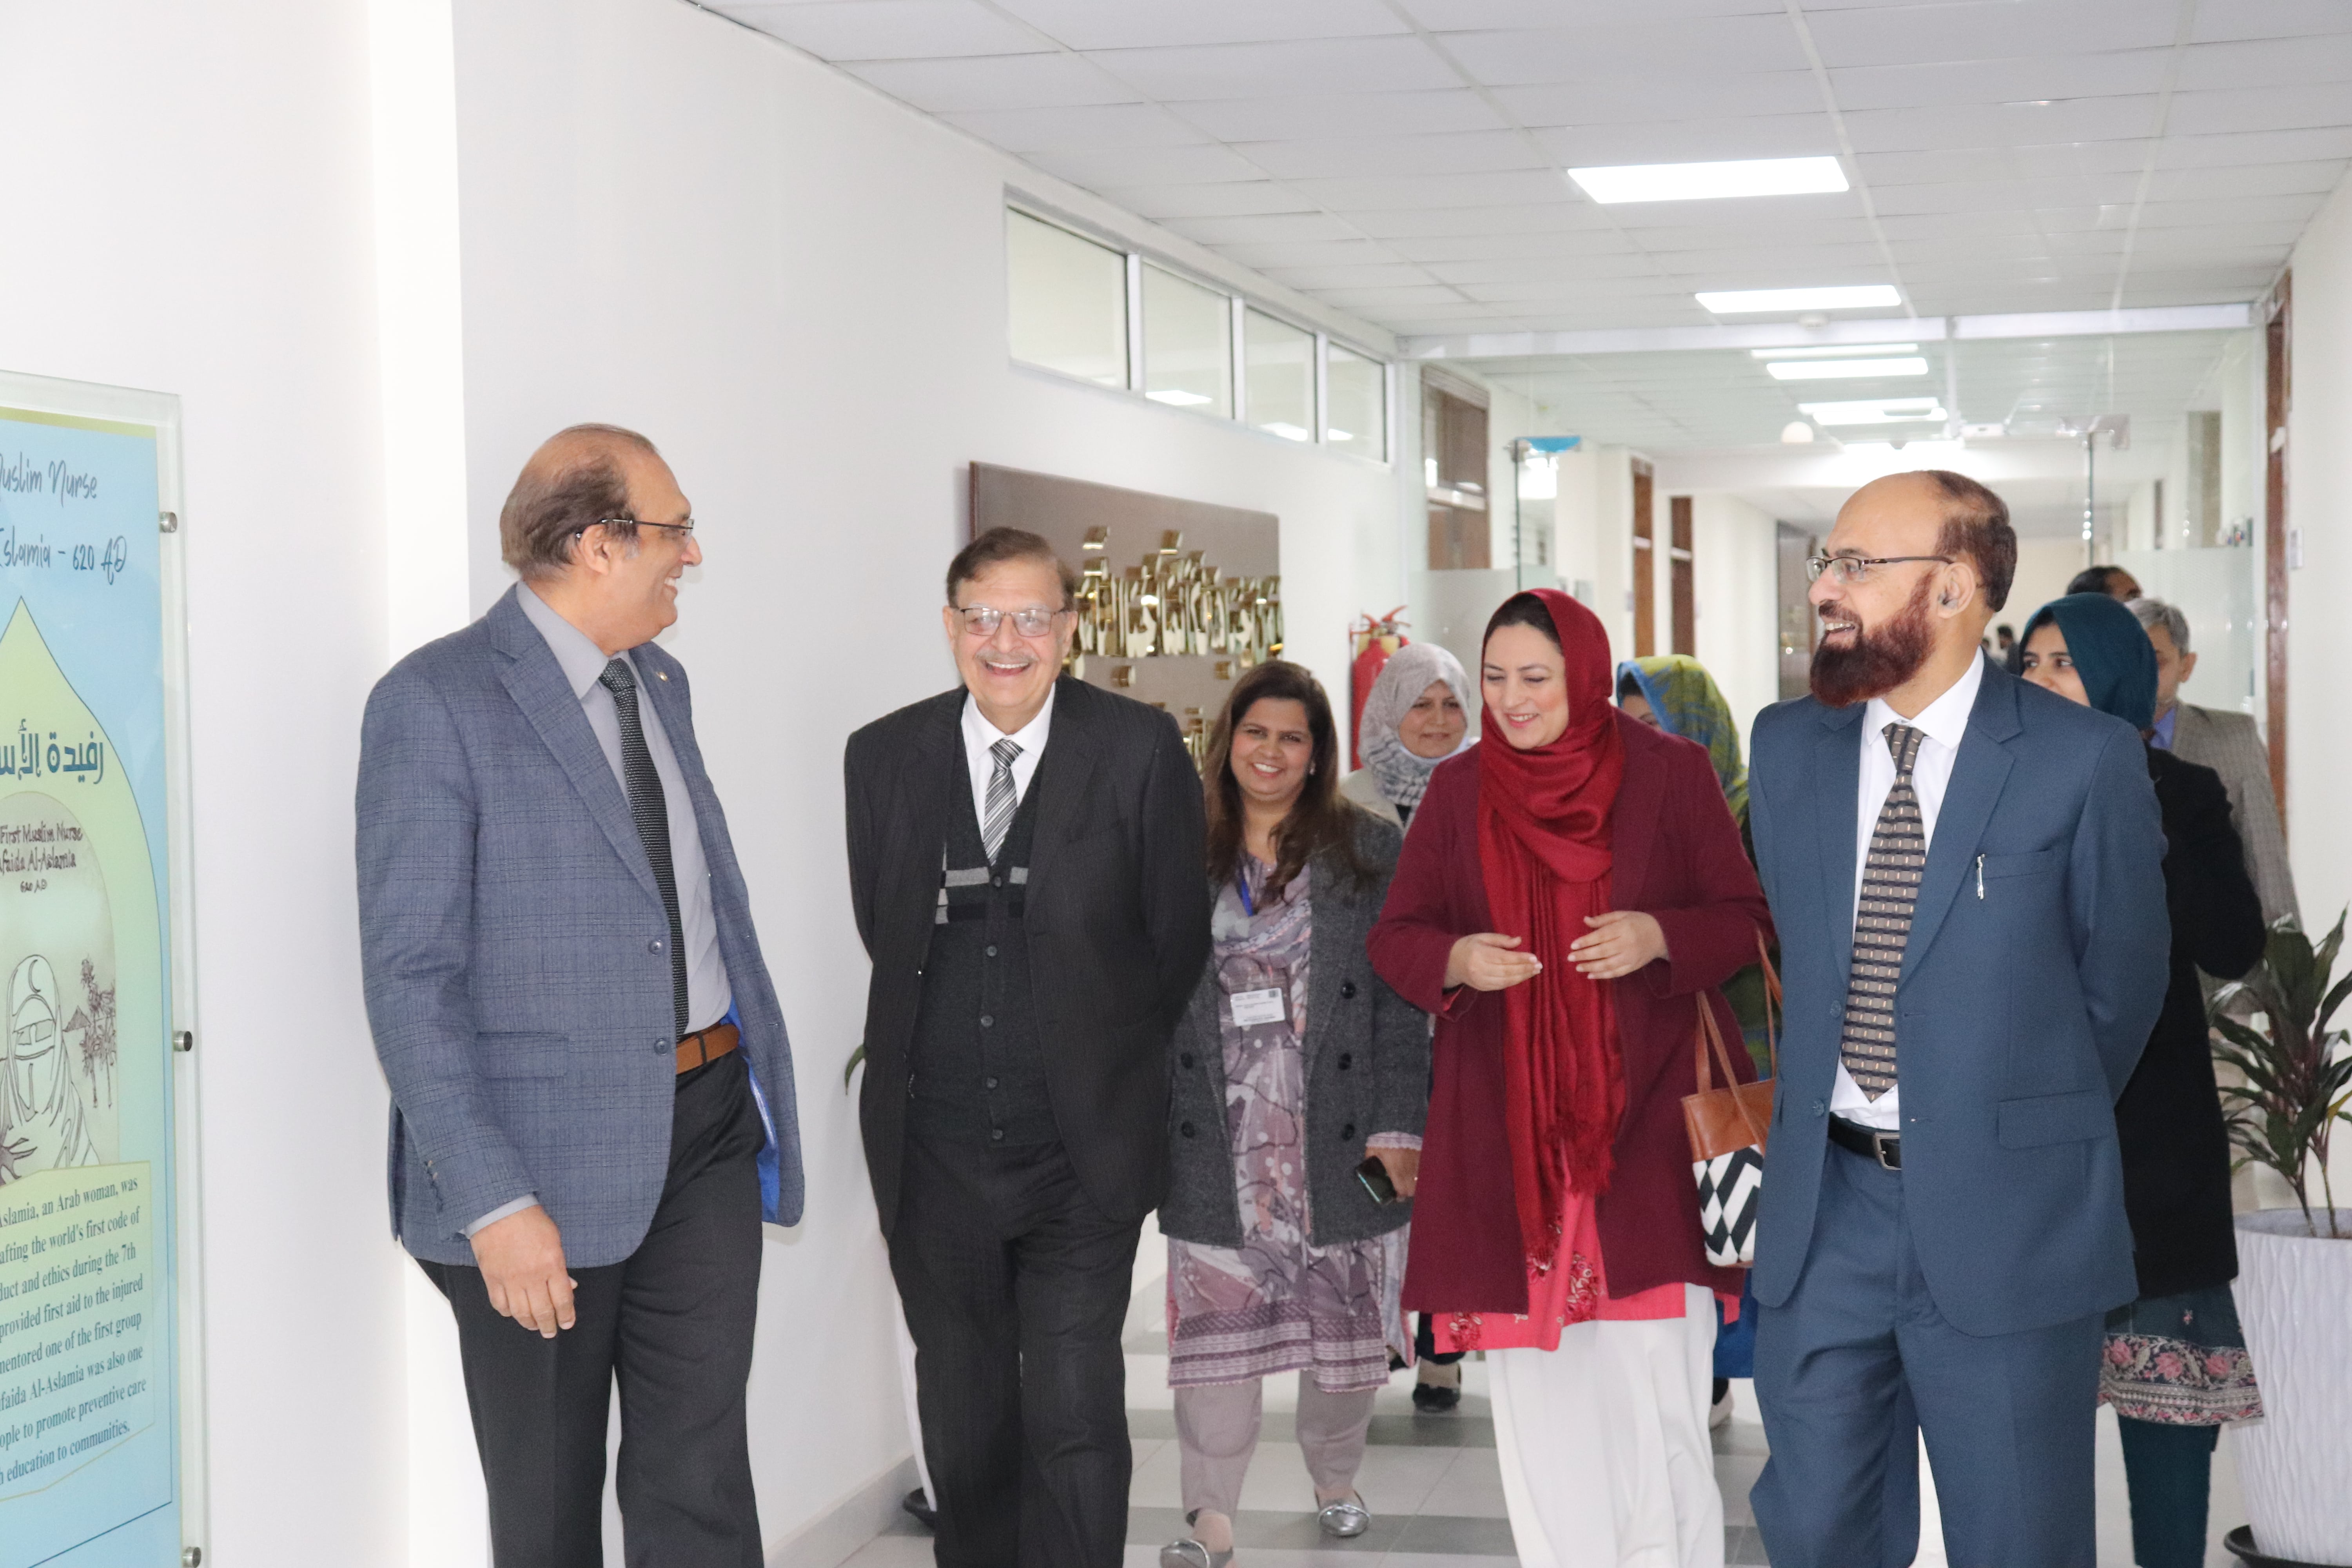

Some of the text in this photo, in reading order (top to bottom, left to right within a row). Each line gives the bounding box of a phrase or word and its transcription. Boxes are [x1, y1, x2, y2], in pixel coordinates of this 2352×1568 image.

[48, 460, 97, 508] Nurse
[0, 525, 51, 568] slamia
[73, 544, 94, 571] 620
[101, 535, 127, 586] AD
[47, 731, 104, 784] رفيدة
[0, 820, 83, 846] First Muslim Nurse
[0, 848, 25, 876] faida
[42, 1200, 53, 1216] an
[56, 1189, 80, 1212] Arab
[83, 1184, 118, 1203] woman,
[121, 1178, 138, 1192] was
[32, 1236, 46, 1254] the
[49, 1223, 83, 1248] world's
[86, 1220, 105, 1238] first
[108, 1211, 128, 1232] code
[131, 1206, 140, 1225] of
[22, 1271, 39, 1294] and
[42, 1265, 70, 1287] ethics
[73, 1255, 102, 1278] during
[105, 1249, 119, 1267] the
[122, 1242, 136, 1261] 7th
[44, 1303, 63, 1323] first
[67, 1293, 81, 1315] aid
[84, 1295, 93, 1310] to
[96, 1287, 109, 1305] the
[113, 1273, 143, 1301] injured
[45, 1340, 62, 1357] one
[65, 1330, 75, 1350] of
[78, 1327, 92, 1346] the
[94, 1321, 113, 1341] first
[116, 1312, 141, 1338] group
[0, 1346, 143, 1411] faida Al-Aslamia was also one
[24, 1422, 33, 1438] to
[36, 1406, 76, 1439] promote
[79, 1386, 124, 1421] preventive
[127, 1379, 146, 1397] care
[7, 1450, 55, 1481] education
[58, 1446, 67, 1461] to
[70, 1420, 130, 1455] communities.
